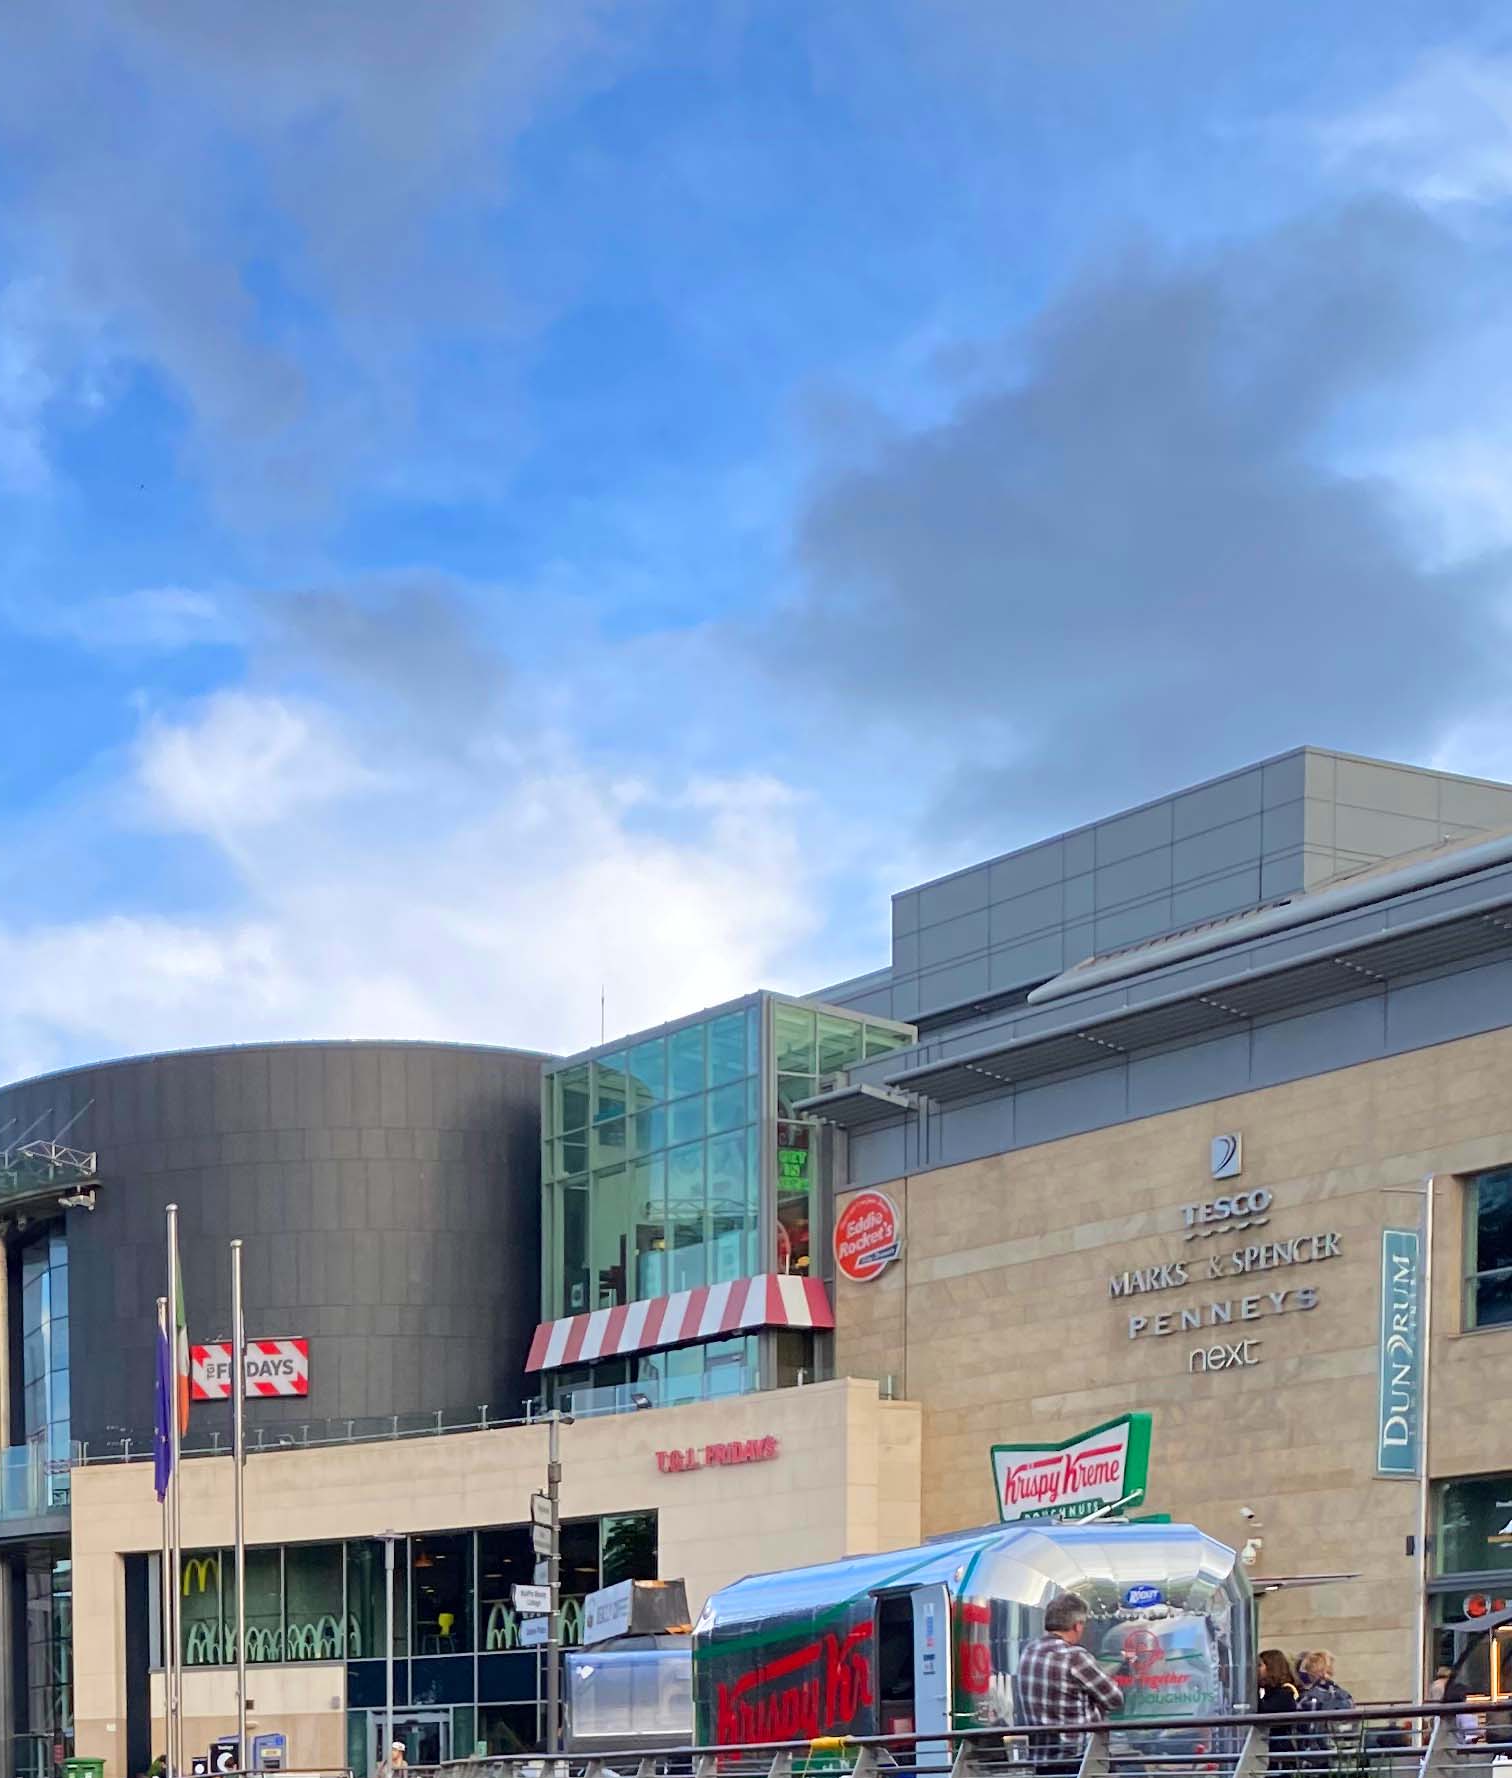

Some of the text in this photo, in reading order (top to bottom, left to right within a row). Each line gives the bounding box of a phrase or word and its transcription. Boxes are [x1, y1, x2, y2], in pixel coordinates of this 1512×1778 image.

[847, 1211, 884, 1239] Eddie
[1180, 1188, 1273, 1226] TESCO
[839, 1222, 894, 1259] Rocket's
[1108, 1233, 1341, 1299] MARKS & SPENCER
[1129, 1287, 1320, 1339] PENNEYS
[216, 1360, 294, 1379] FDAYS
[1189, 1339, 1264, 1373] next
[705, 1435, 778, 1466] FRIDAYS
[1004, 1443, 1123, 1506] Krispy Kreme
